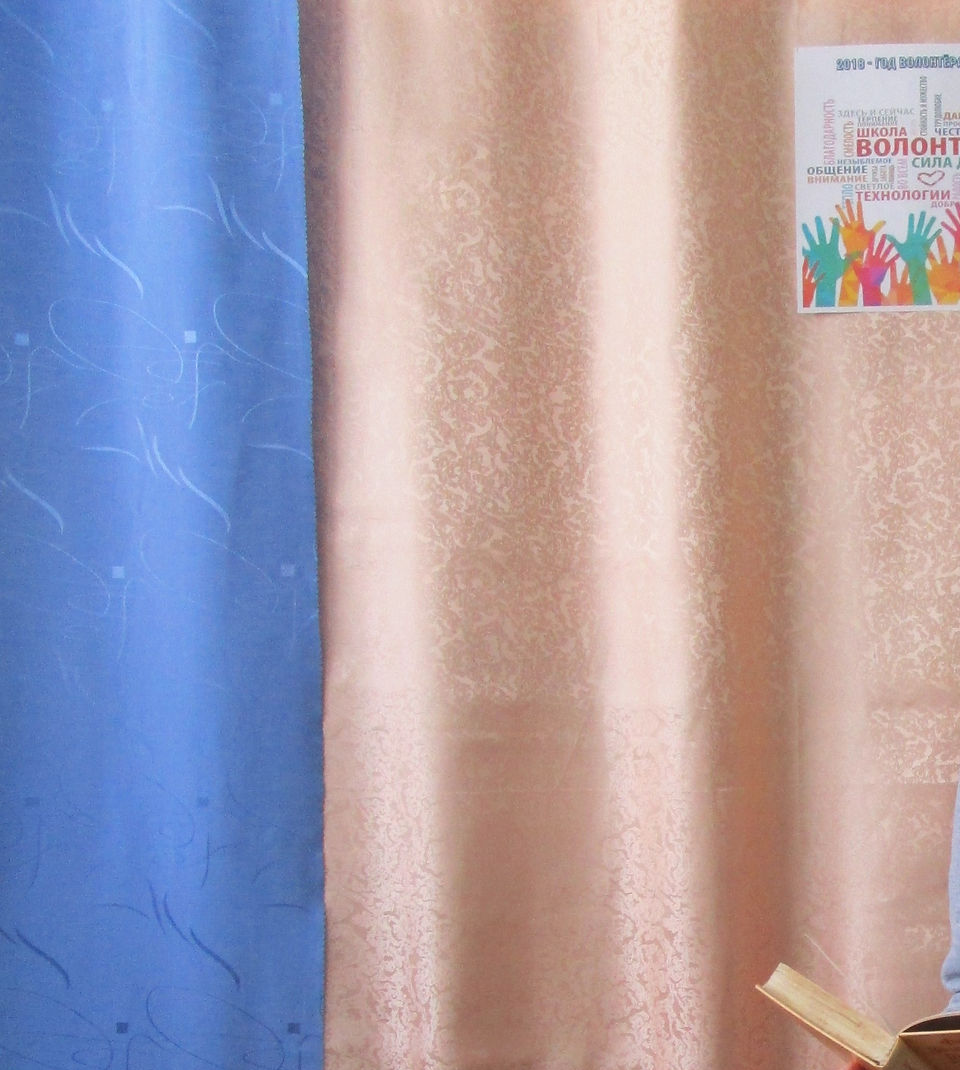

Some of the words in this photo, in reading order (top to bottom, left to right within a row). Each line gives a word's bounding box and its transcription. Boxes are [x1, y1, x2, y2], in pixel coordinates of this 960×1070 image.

[836, 58, 865, 70] 2018
[875, 57, 897, 71] ГОД
[879, 107, 915, 116] СЕЙЧАС
[823, 99, 837, 166] БЛАГОДАРНОСТЬ
[857, 127, 907, 138] ШКОЛА
[912, 157, 952, 168] СИЛА
[807, 165, 868, 176] ОБЩЕНИЕ
[807, 175, 868, 184] ВНИМАНИЕ
[855, 183, 894, 191] СВЕТЛОЕ
[855, 190, 951, 201] ТЕХНОЛОГИИ
